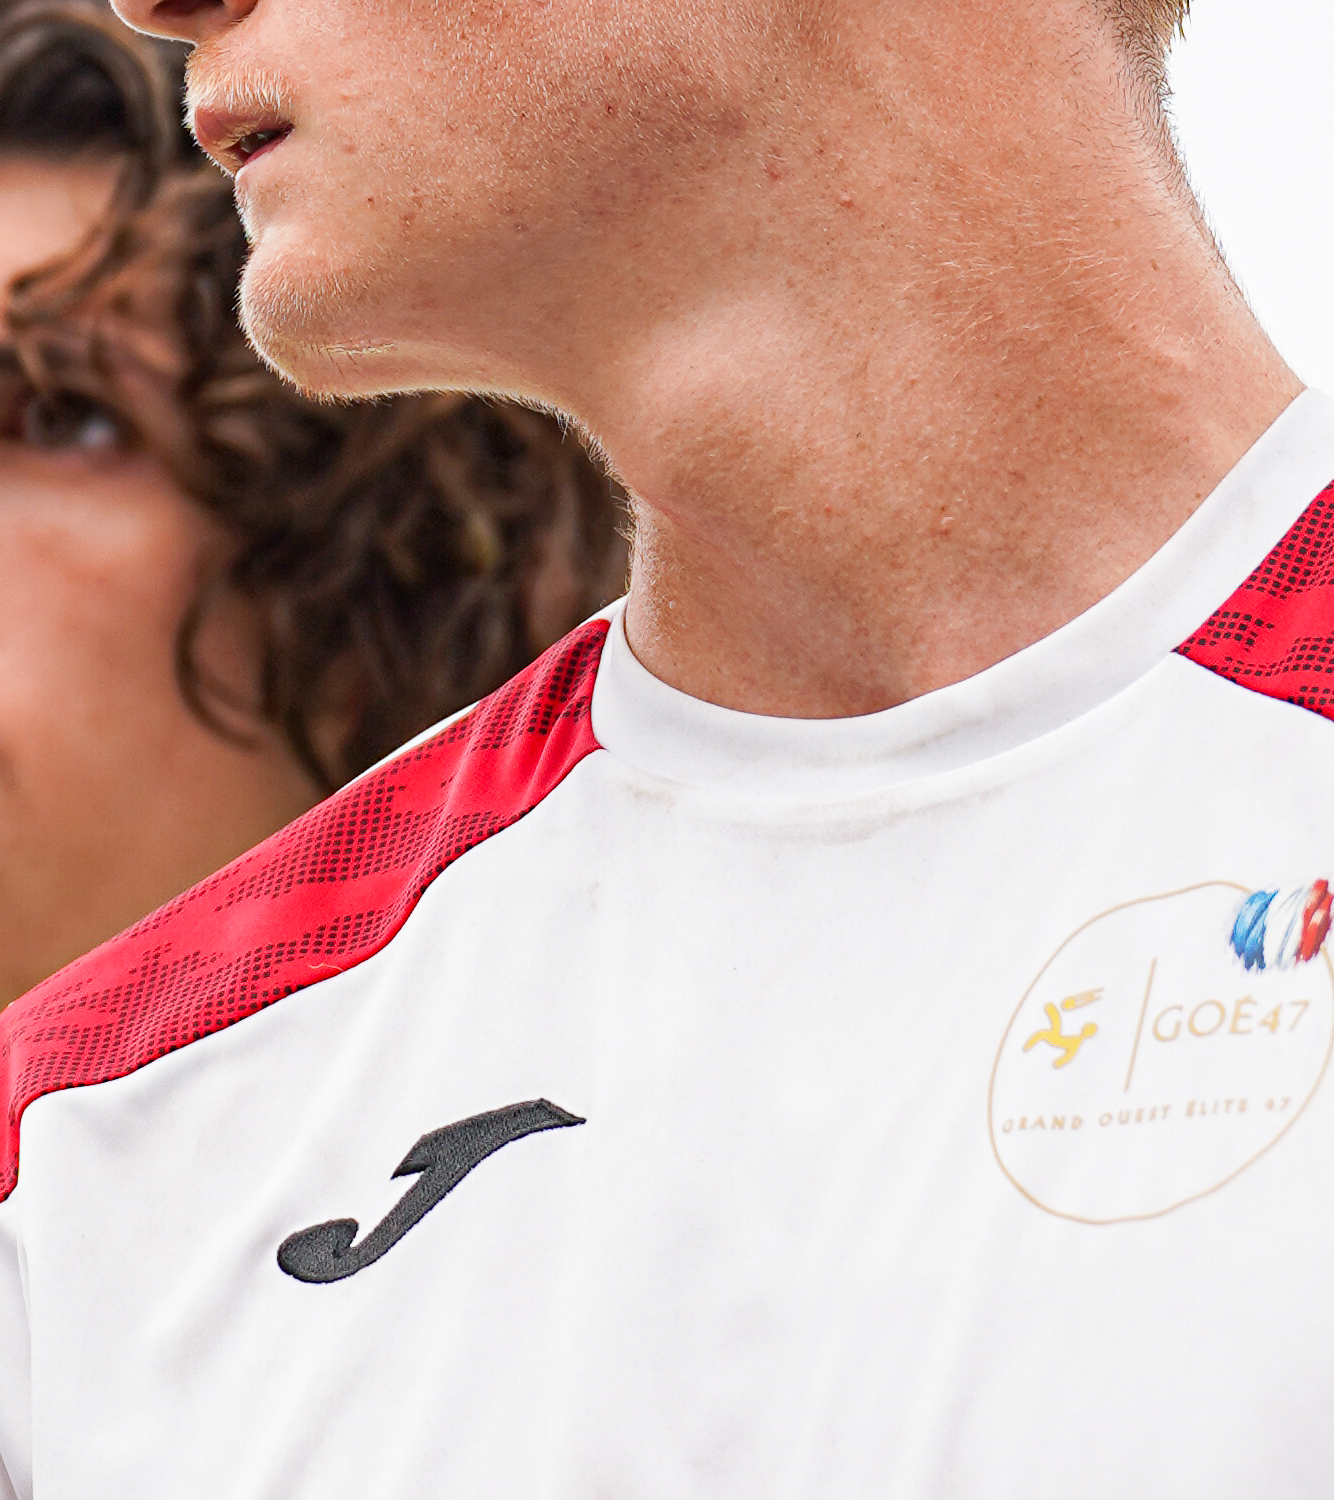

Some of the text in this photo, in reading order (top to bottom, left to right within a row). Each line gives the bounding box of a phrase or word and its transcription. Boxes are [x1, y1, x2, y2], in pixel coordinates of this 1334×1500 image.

[1002, 1114, 1084, 1134] GRAND
[1098, 1104, 1171, 1127] OUEST
[1264, 1096, 1292, 1112] 47
